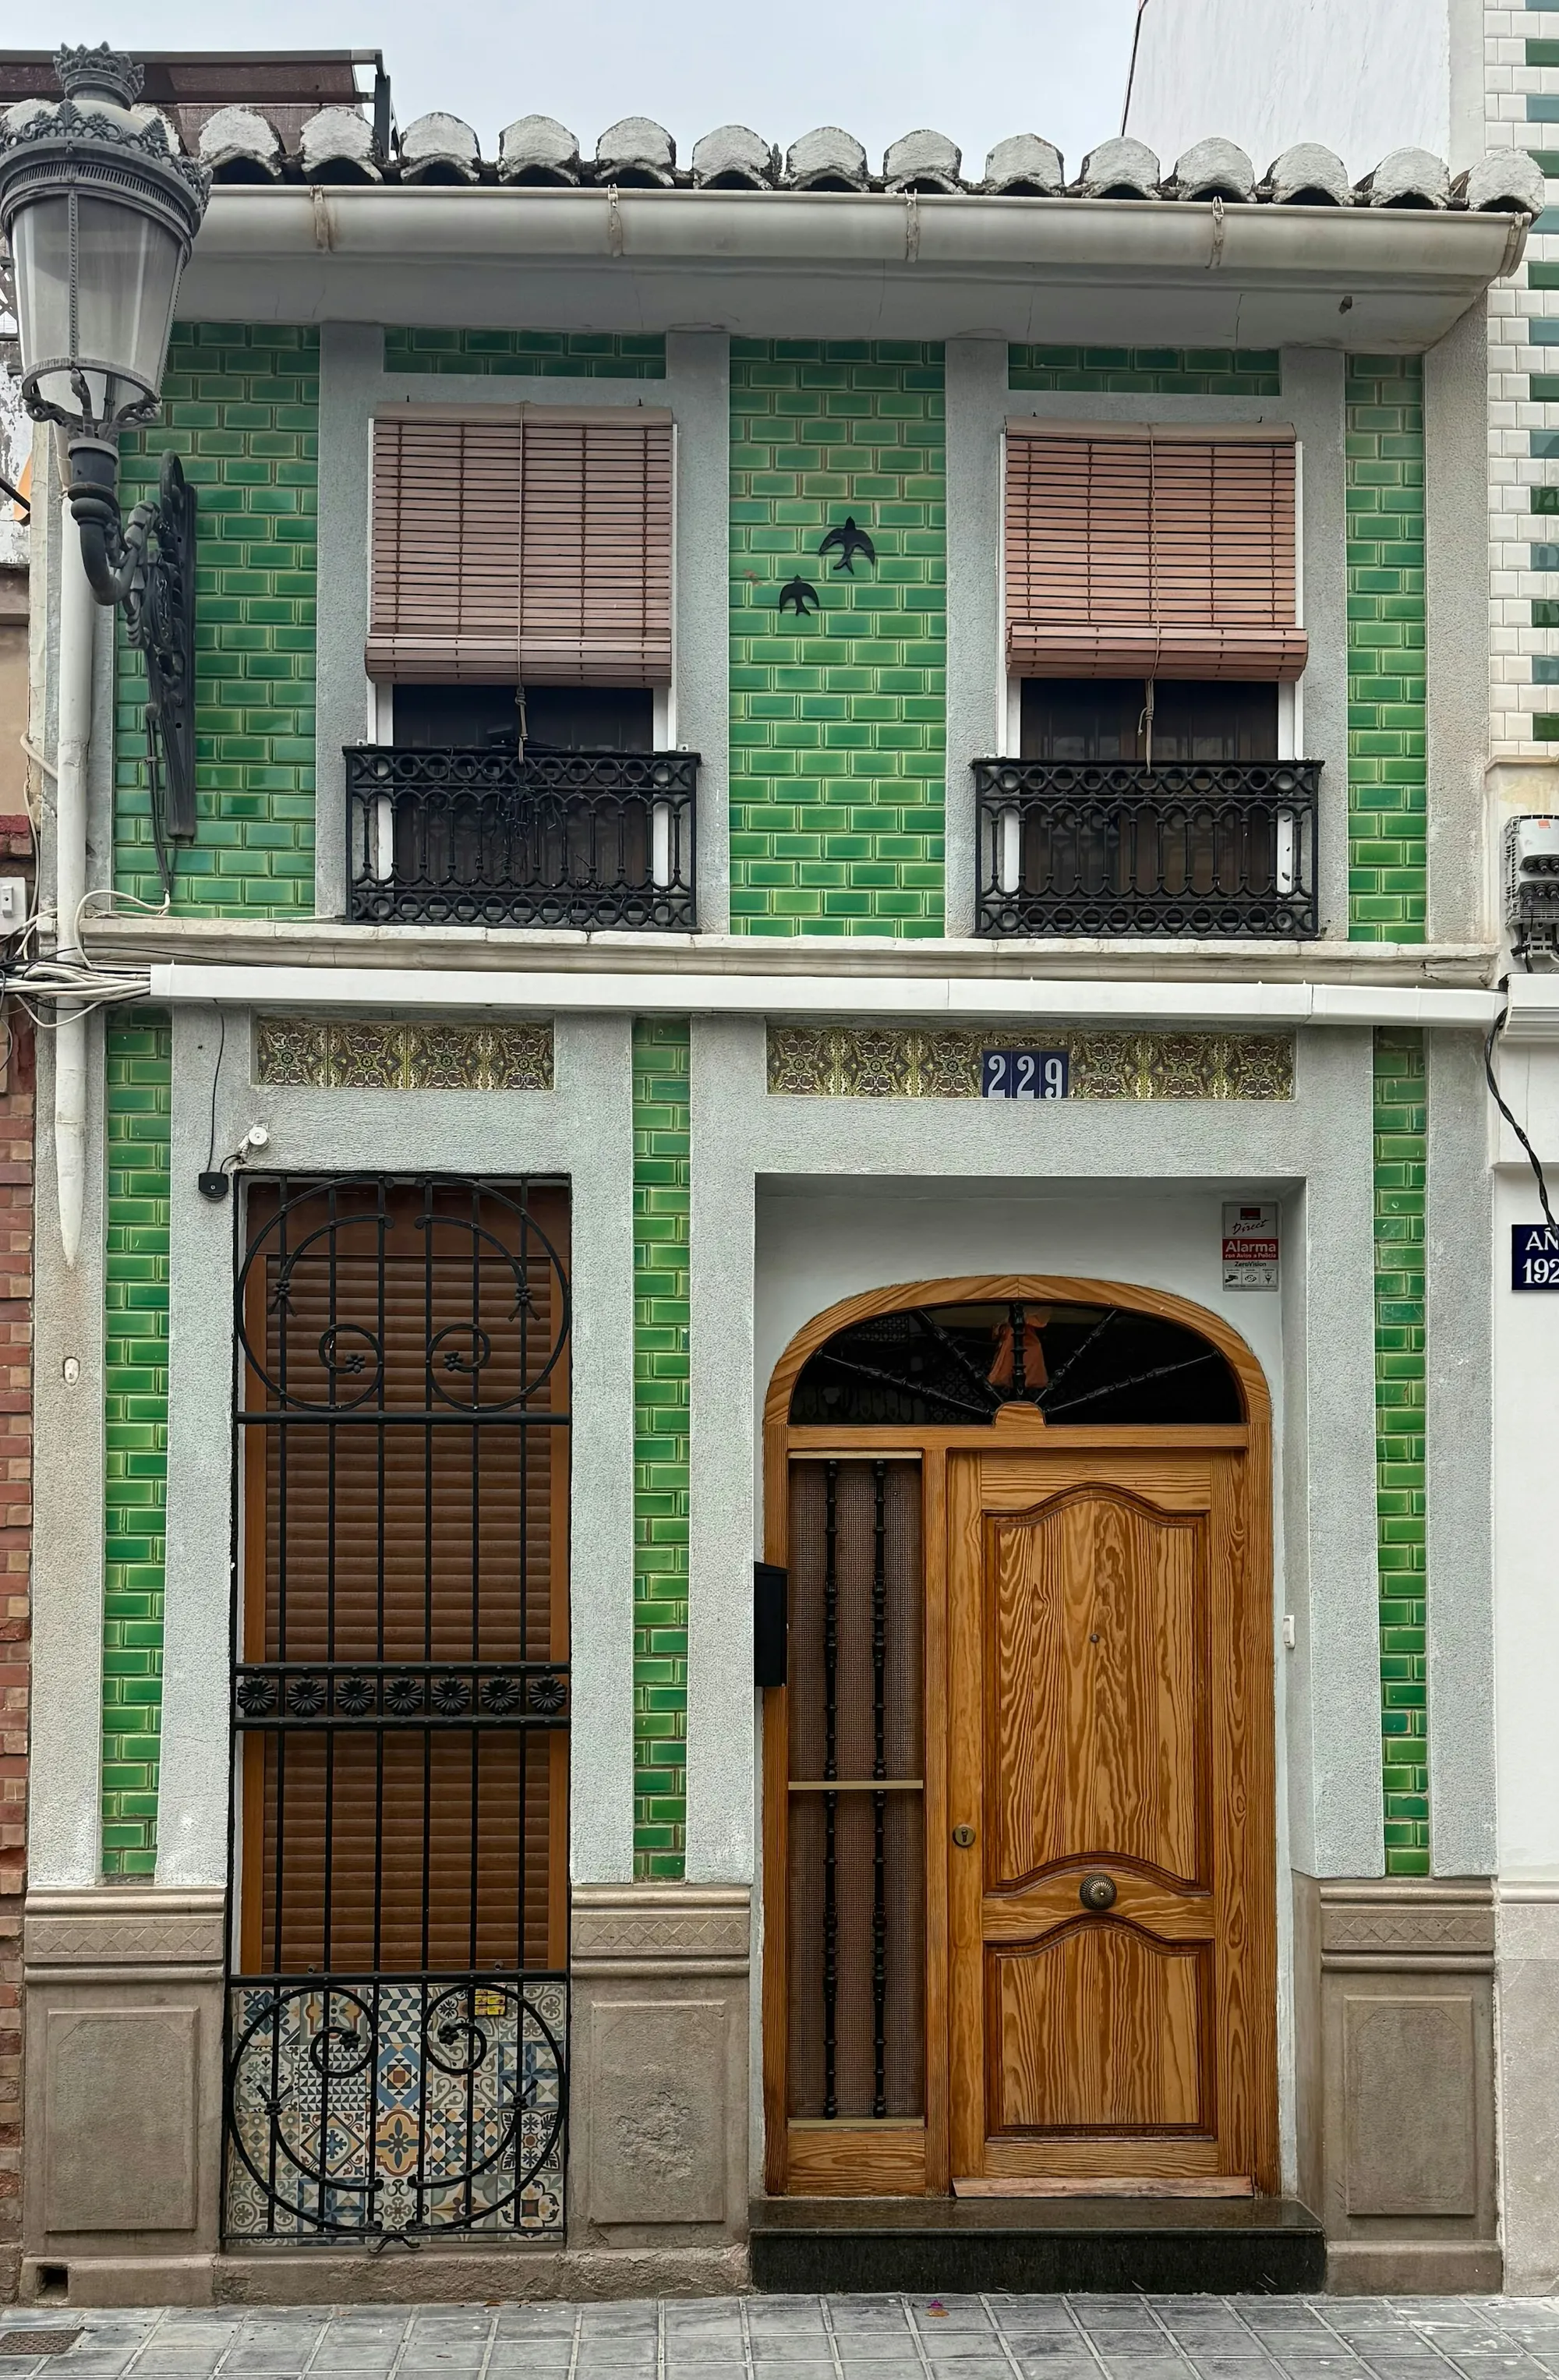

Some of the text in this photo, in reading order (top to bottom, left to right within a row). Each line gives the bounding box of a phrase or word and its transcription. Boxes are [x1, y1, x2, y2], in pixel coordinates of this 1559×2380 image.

[988, 1055, 1062, 1099] 229
[1232, 1218, 1270, 1235] Direct
[1225, 1240, 1276, 1253] Alarma
[1522, 1258, 1559, 1284] 192
